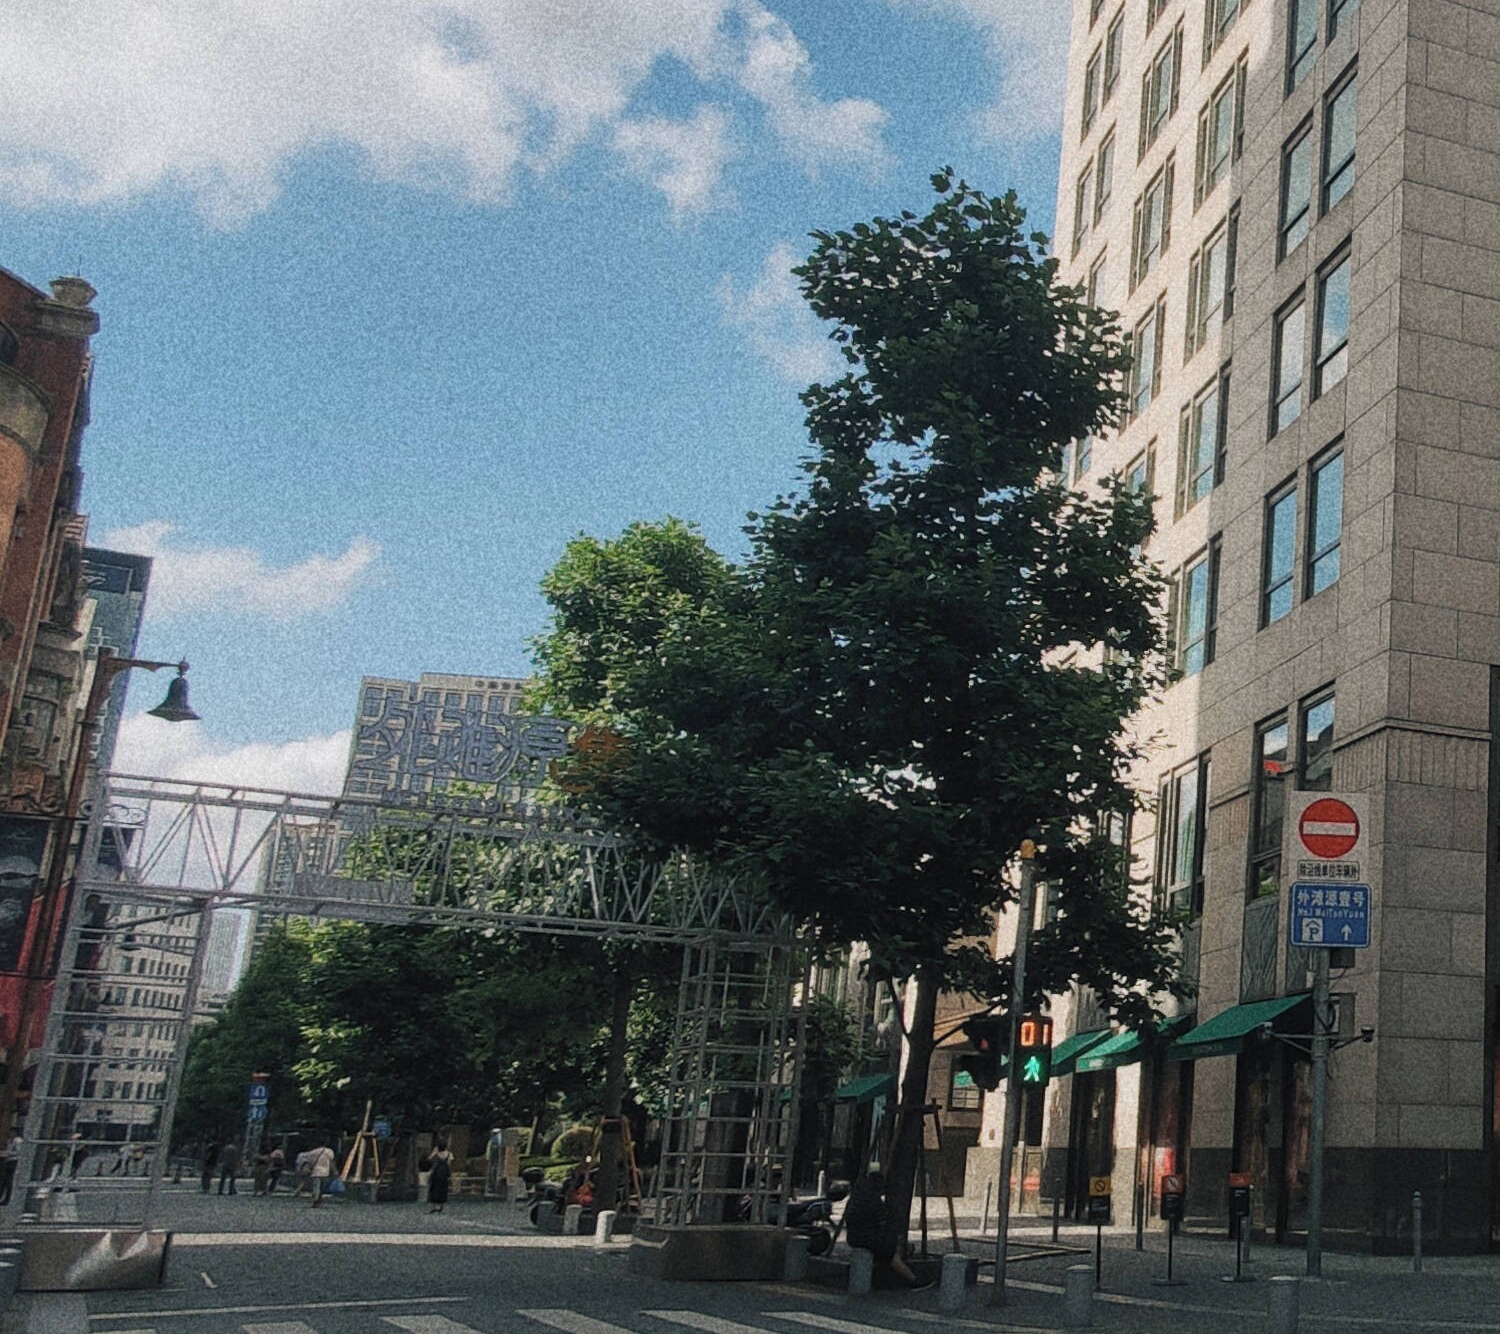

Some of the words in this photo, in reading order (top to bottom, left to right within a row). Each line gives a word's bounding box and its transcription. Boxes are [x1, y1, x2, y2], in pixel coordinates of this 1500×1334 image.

[1297, 890, 1365, 907] 外滩源壹号
